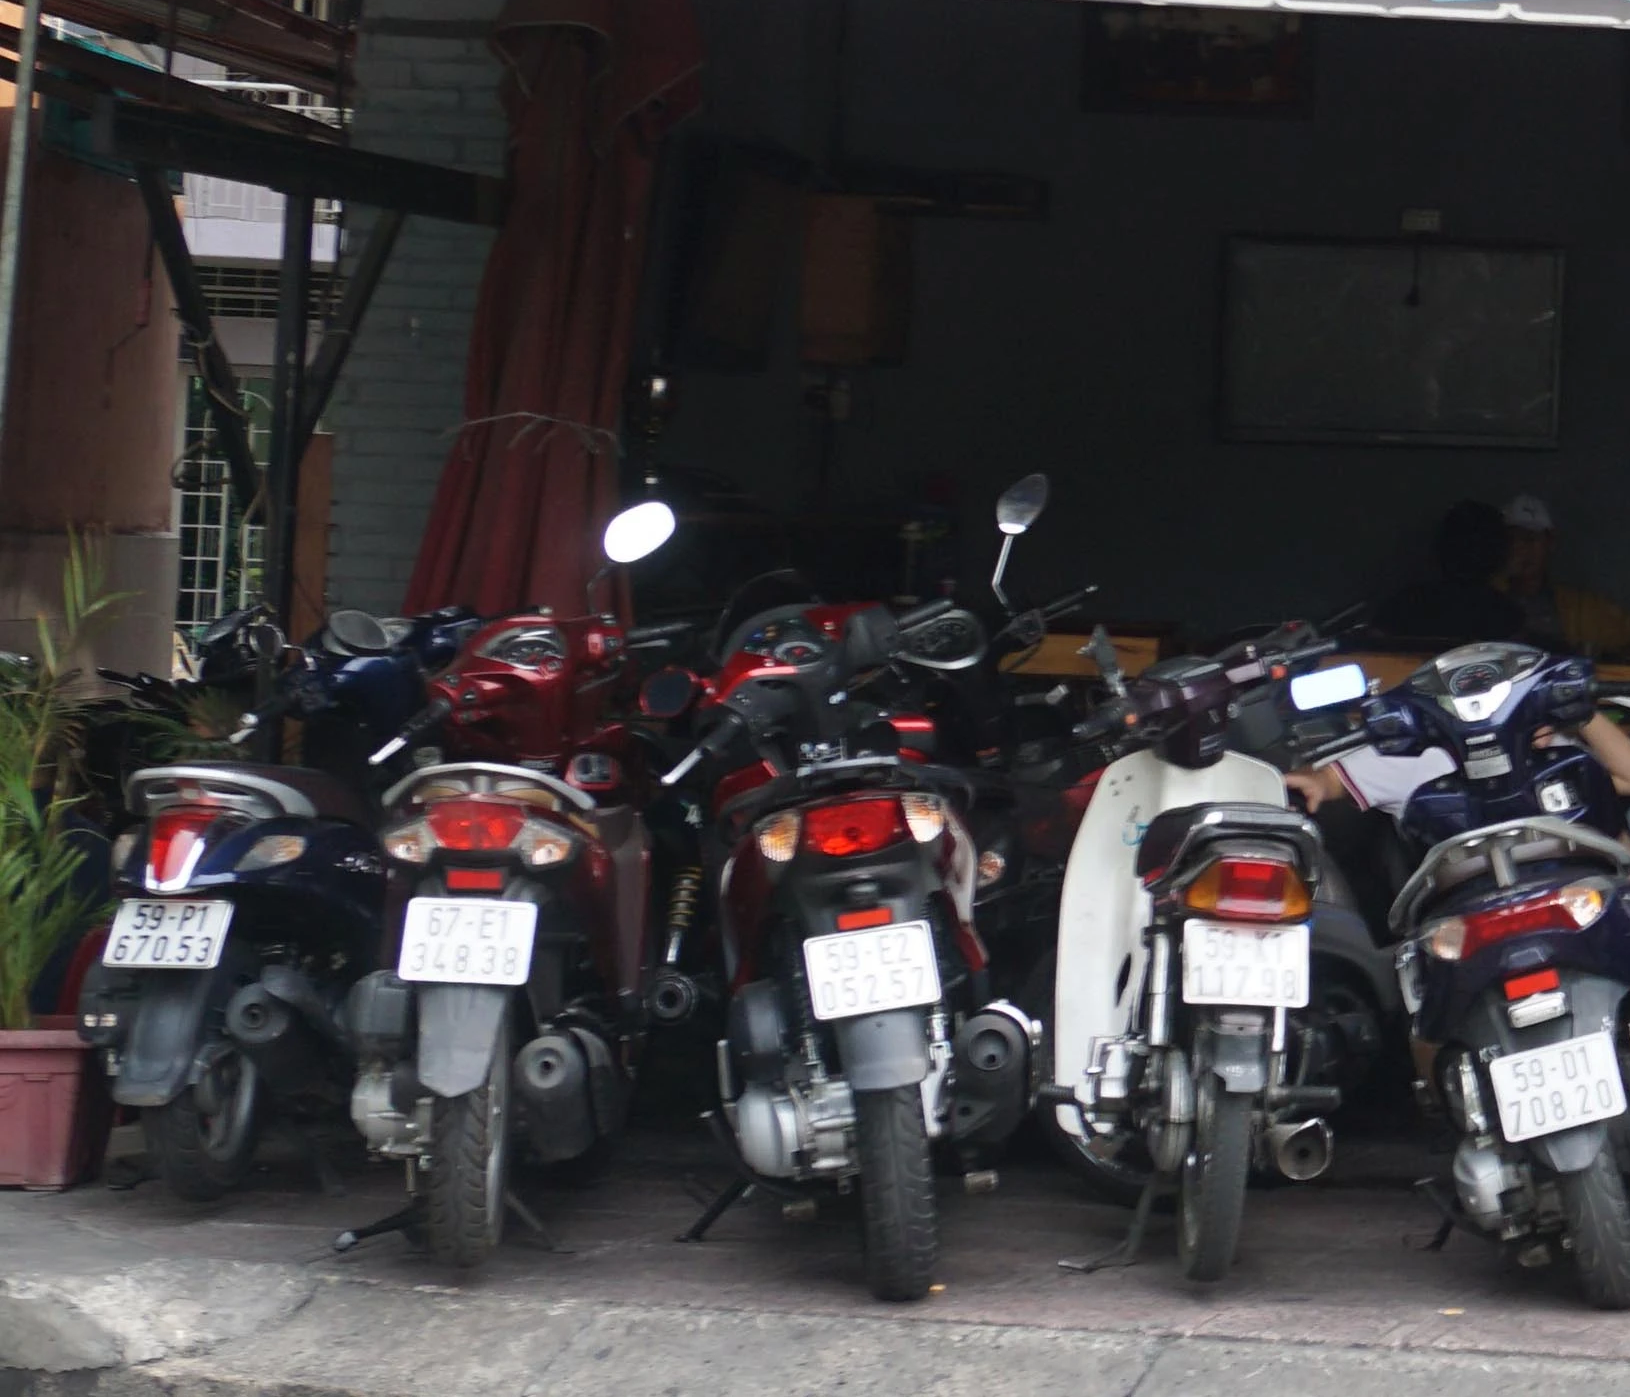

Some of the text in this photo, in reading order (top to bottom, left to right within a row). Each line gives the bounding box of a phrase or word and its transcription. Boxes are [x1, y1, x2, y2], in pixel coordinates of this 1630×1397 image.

[133, 905, 209, 931] 59-P1
[428, 907, 508, 939] 67-E1
[114, 935, 212, 962] 670.53
[411, 943, 518, 975] 348.38
[1508, 1079, 1613, 1135] 708.20
